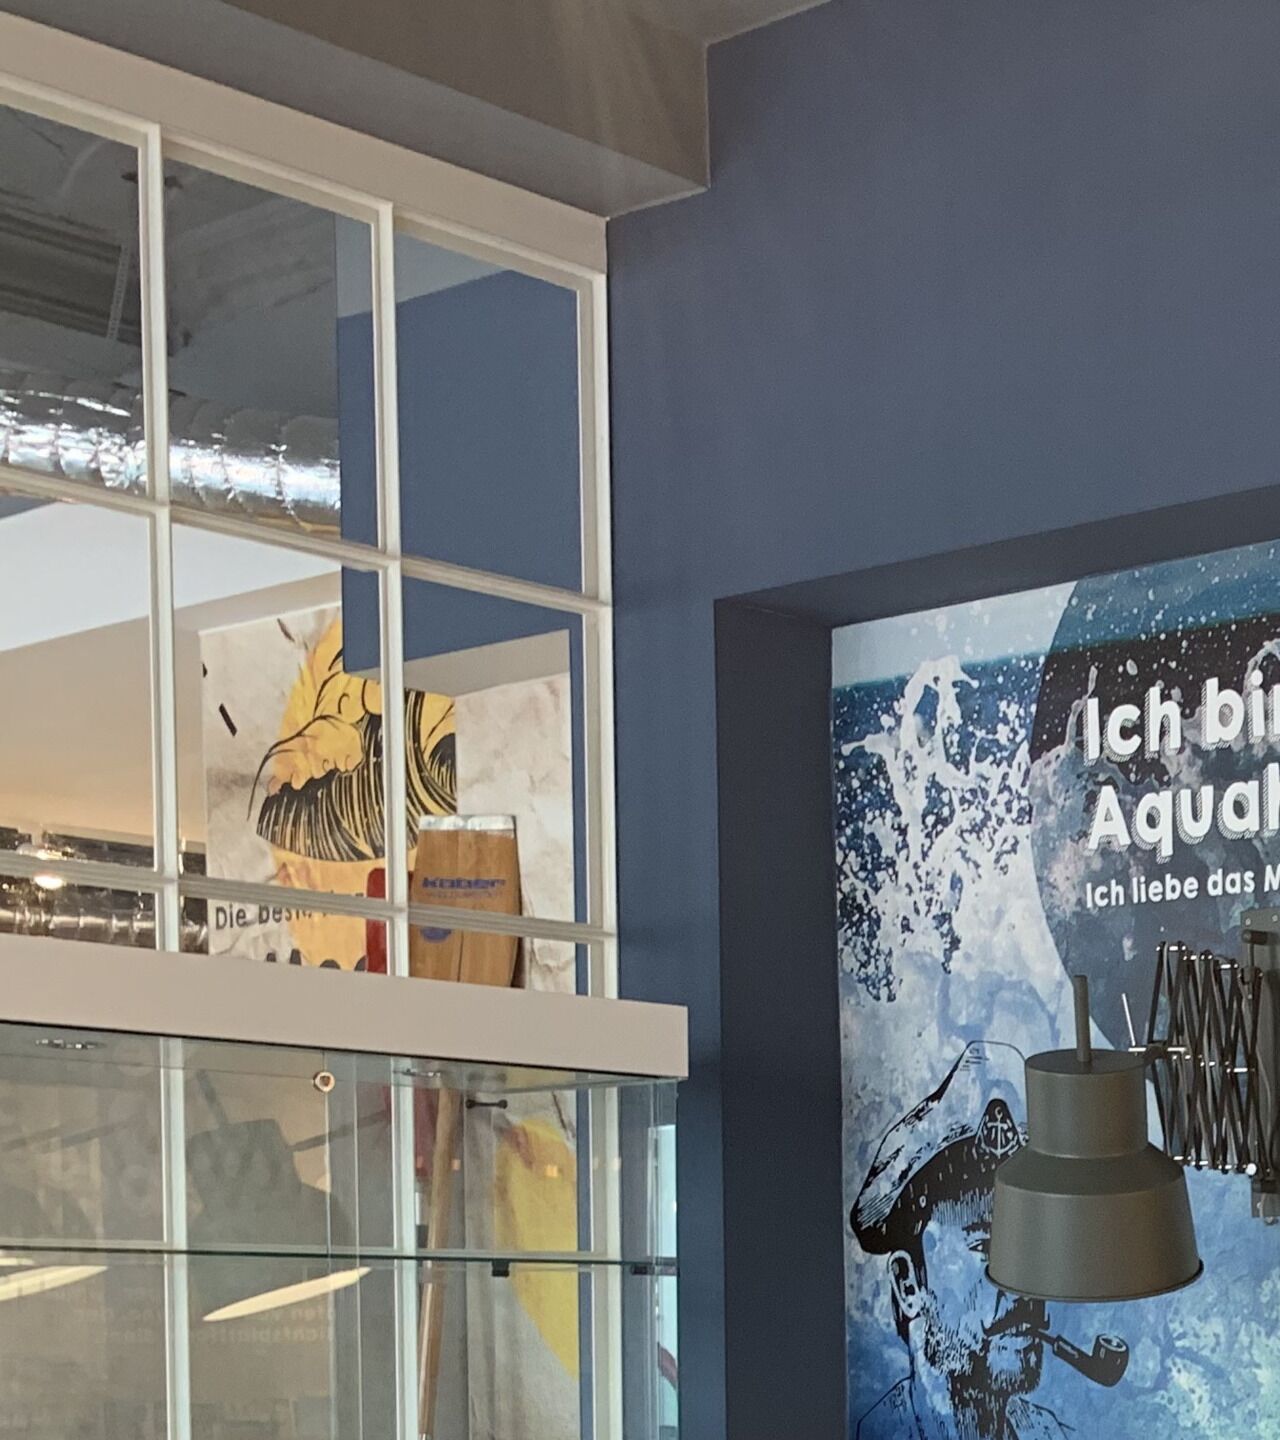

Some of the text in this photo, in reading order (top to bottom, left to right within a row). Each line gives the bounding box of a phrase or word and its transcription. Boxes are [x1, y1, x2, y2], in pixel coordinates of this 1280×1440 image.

[1083, 683, 1182, 766] Ich
[1085, 881, 1125, 909] Ich
[1132, 870, 1199, 904] liebe
[1207, 864, 1256, 896] das
[215, 903, 247, 931] Die
